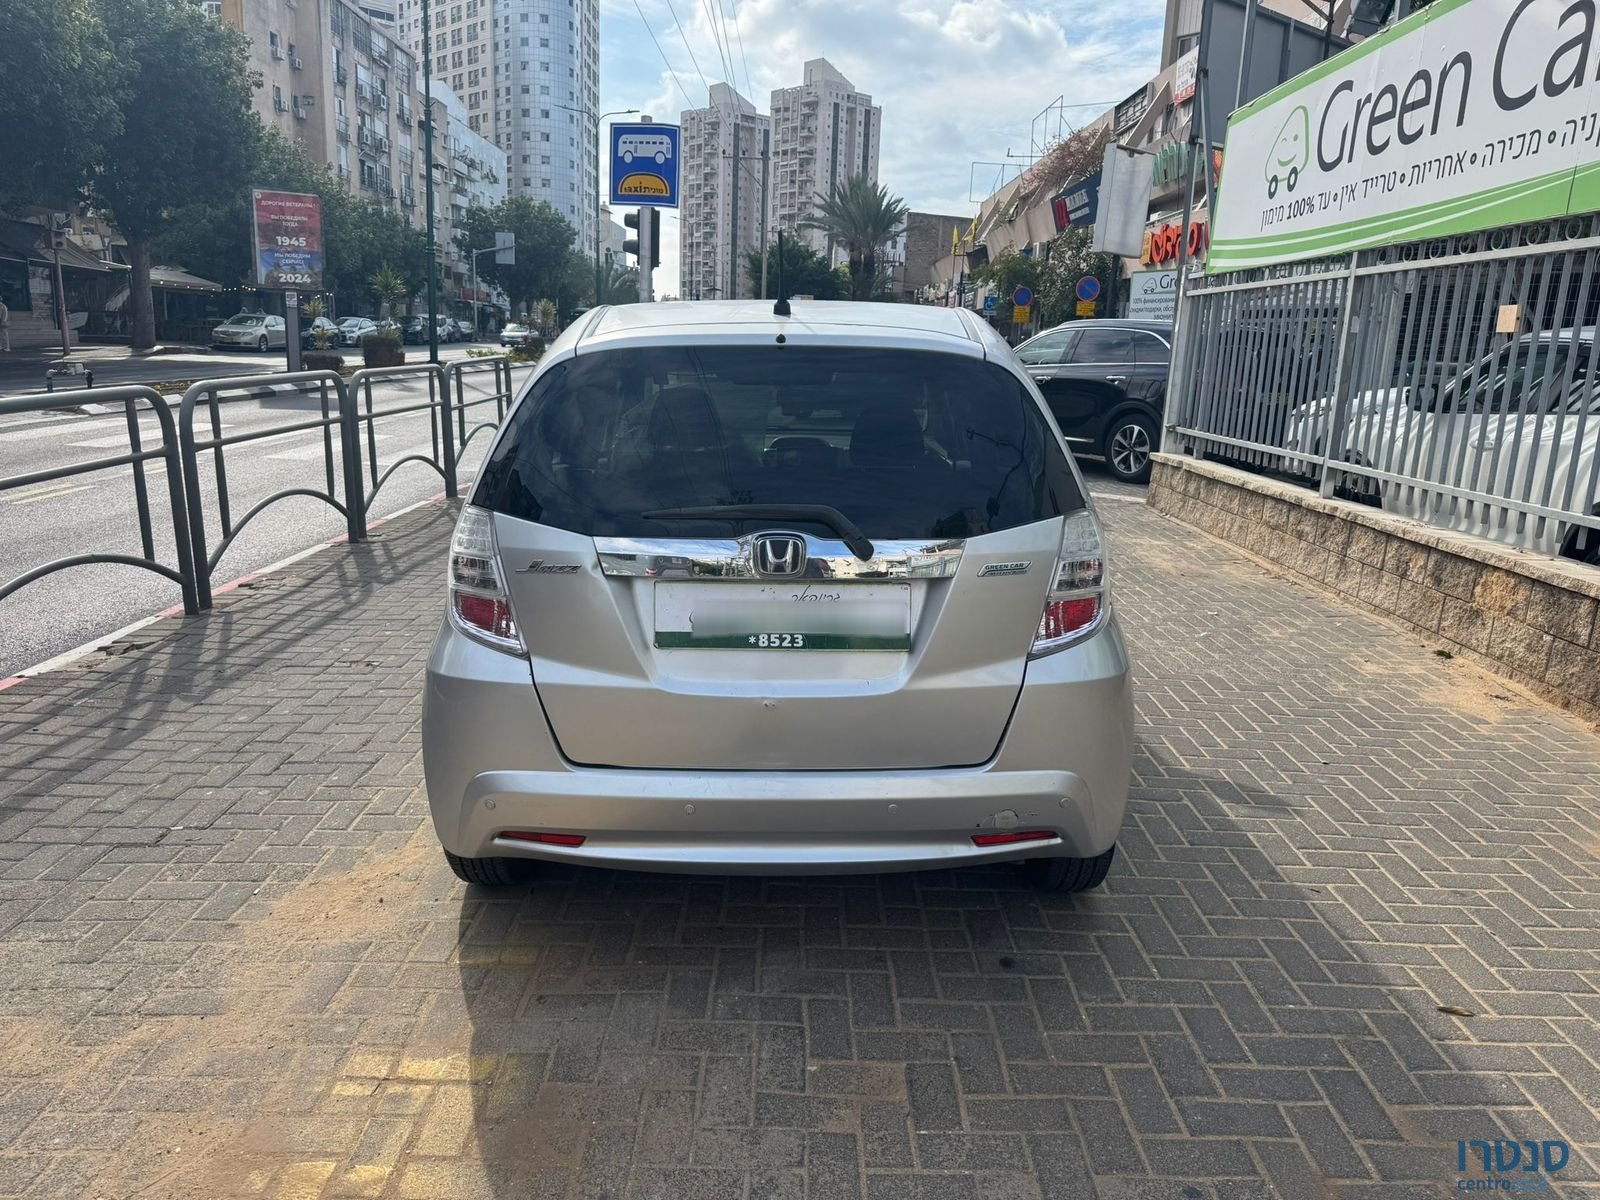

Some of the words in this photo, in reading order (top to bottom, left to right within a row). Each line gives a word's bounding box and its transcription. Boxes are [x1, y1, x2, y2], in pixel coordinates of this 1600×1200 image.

[1317, 51, 1472, 172] Green
[1492, 0, 1600, 111] Ca
[1482, 129, 1541, 168] מכירה
[1408, 150, 1467, 187] אחריות
[1339, 182, 1358, 211] אין
[1362, 171, 1397, 198] טרייד
[1287, 195, 1315, 220] 100%
[1318, 191, 1331, 211] עד
[1261, 205, 1284, 232] מימון
[276, 236, 306, 246] 1945
[279, 273, 311, 283] 2024
